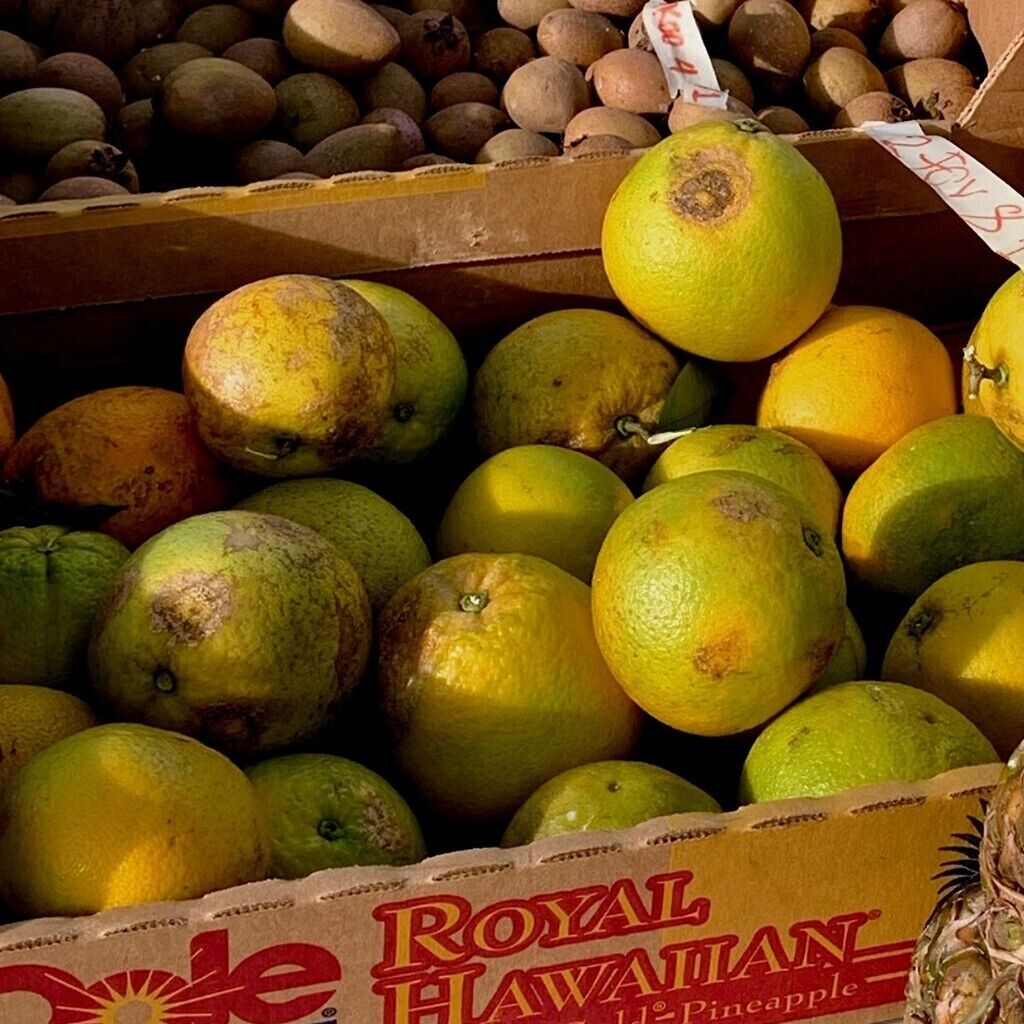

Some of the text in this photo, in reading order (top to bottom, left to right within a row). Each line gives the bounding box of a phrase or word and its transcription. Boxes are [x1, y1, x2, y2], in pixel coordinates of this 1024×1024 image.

[371, 910, 868, 1024] HAWAIIAN
[372, 870, 711, 978] ROYAL
[680, 972, 859, 1023] Pineapple
